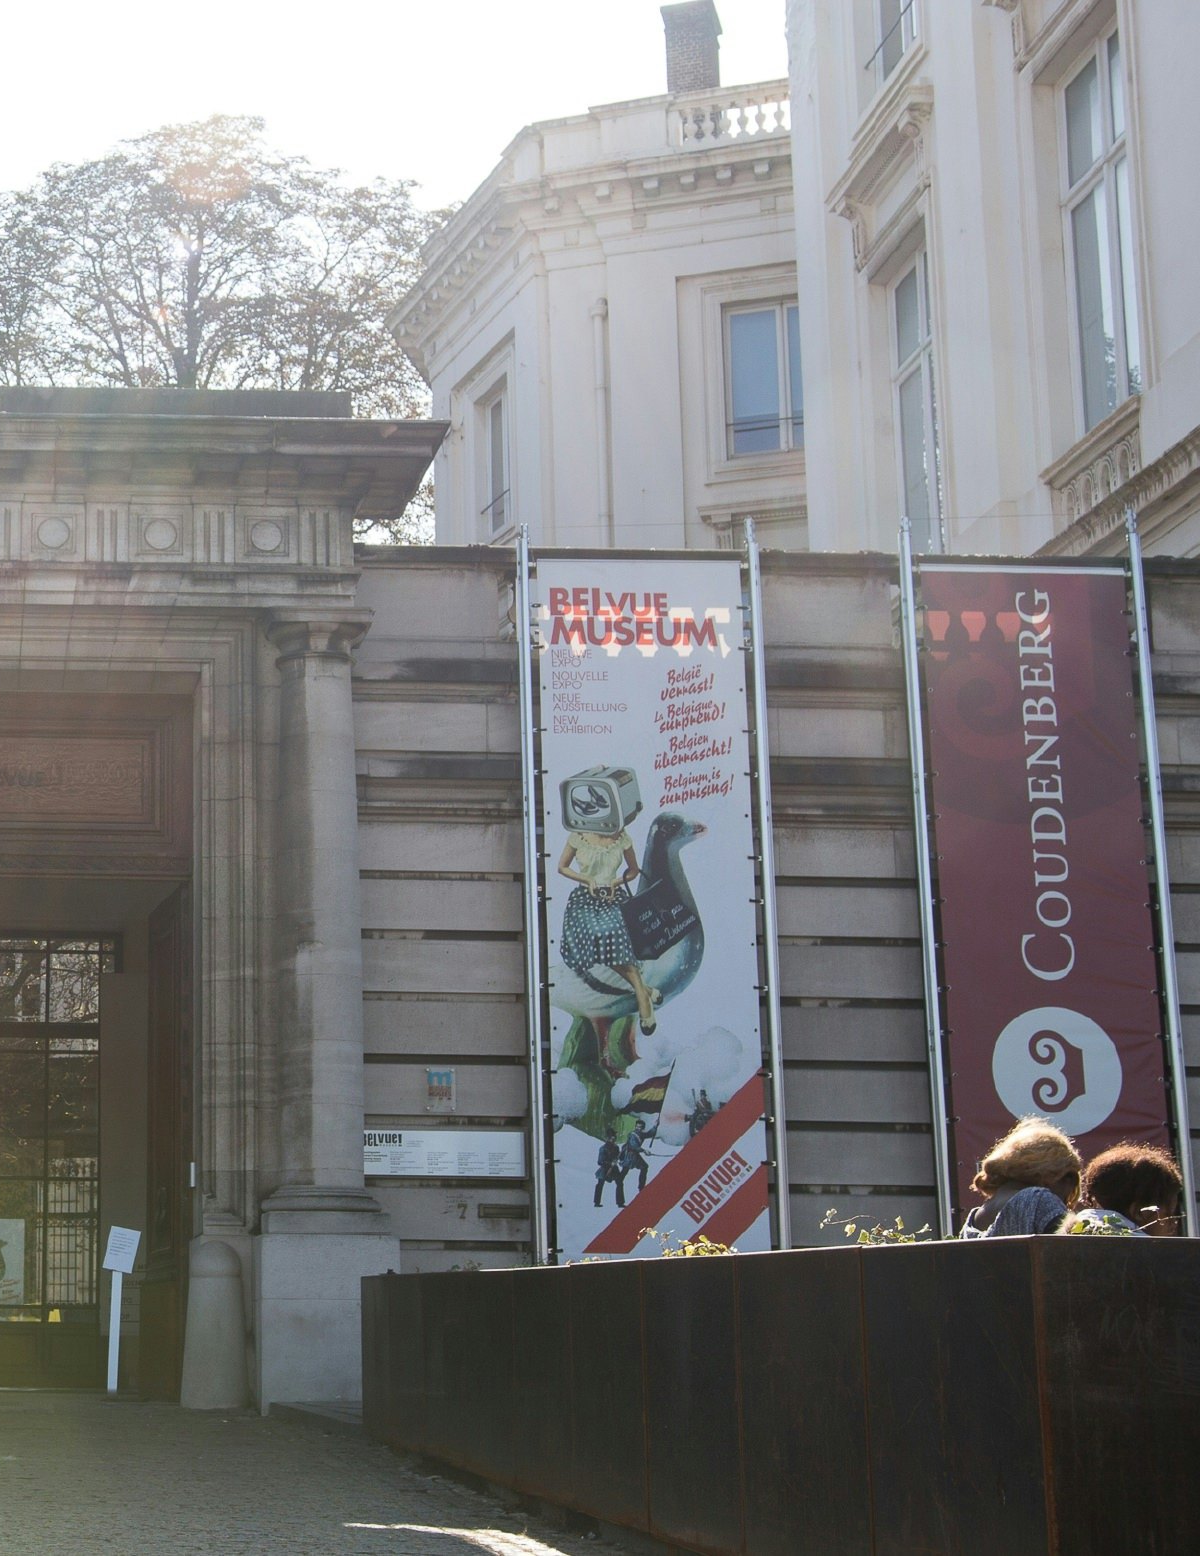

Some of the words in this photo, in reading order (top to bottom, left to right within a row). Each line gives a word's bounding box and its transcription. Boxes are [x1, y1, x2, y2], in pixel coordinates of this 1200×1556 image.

[549, 587, 668, 617] BELVUE
[551, 616, 718, 647] MUSEUM
[552, 649, 592, 659] NIEUWE
[552, 659, 581, 668] EXPO
[552, 671, 609, 681] NOUVELLE
[552, 680, 582, 690] EXPO
[667, 664, 702, 686] België
[661, 673, 714, 701] verrast!
[552, 693, 581, 703] NEUE
[553, 702, 628, 712] AUSSTELLUNG
[553, 715, 579, 725] NEW
[659, 702, 726, 734] surprend!
[667, 700, 713, 721] Belgique
[553, 724, 612, 734] EXHIBITION
[654, 736, 732, 771] überrascht!
[669, 732, 709, 754] Belgien
[664, 771, 708, 793] Belgium
[711, 766, 721, 780] is
[1015, 587, 1075, 982] COUDENBERG
[659, 773, 734, 808] surprising!
[457, 1203, 468, 1219] 7
